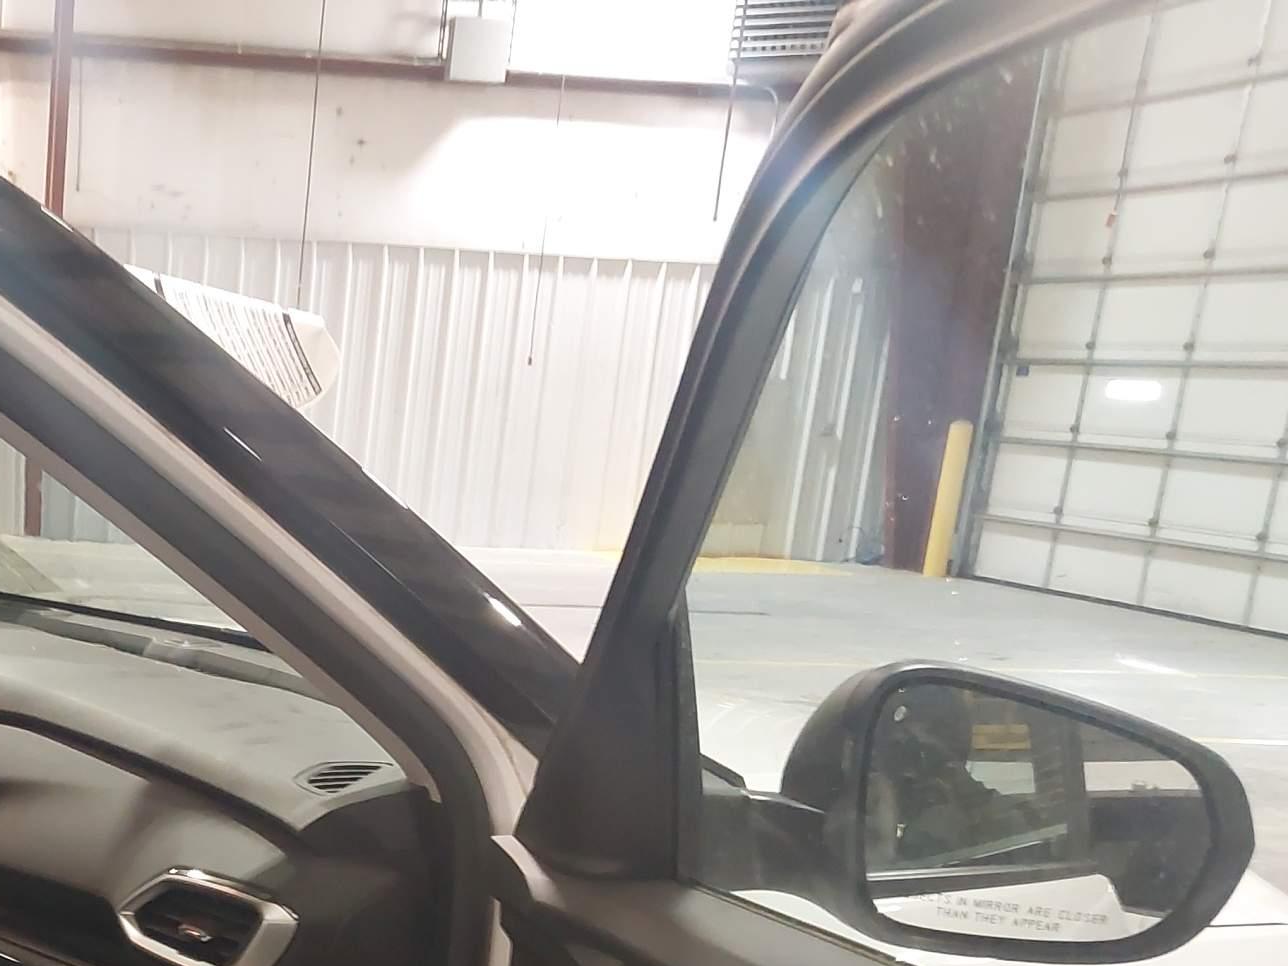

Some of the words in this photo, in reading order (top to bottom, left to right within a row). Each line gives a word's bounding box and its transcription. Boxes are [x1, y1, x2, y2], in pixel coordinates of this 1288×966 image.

[935, 906, 968, 919] THAN
[974, 912, 1003, 925] THEY
[1012, 917, 1061, 932] APPEAR
[956, 896, 968, 907] IN
[972, 898, 1020, 913] MIRROR
[1027, 906, 1052, 918] ARE
[1057, 910, 1108, 925] CLOSER
